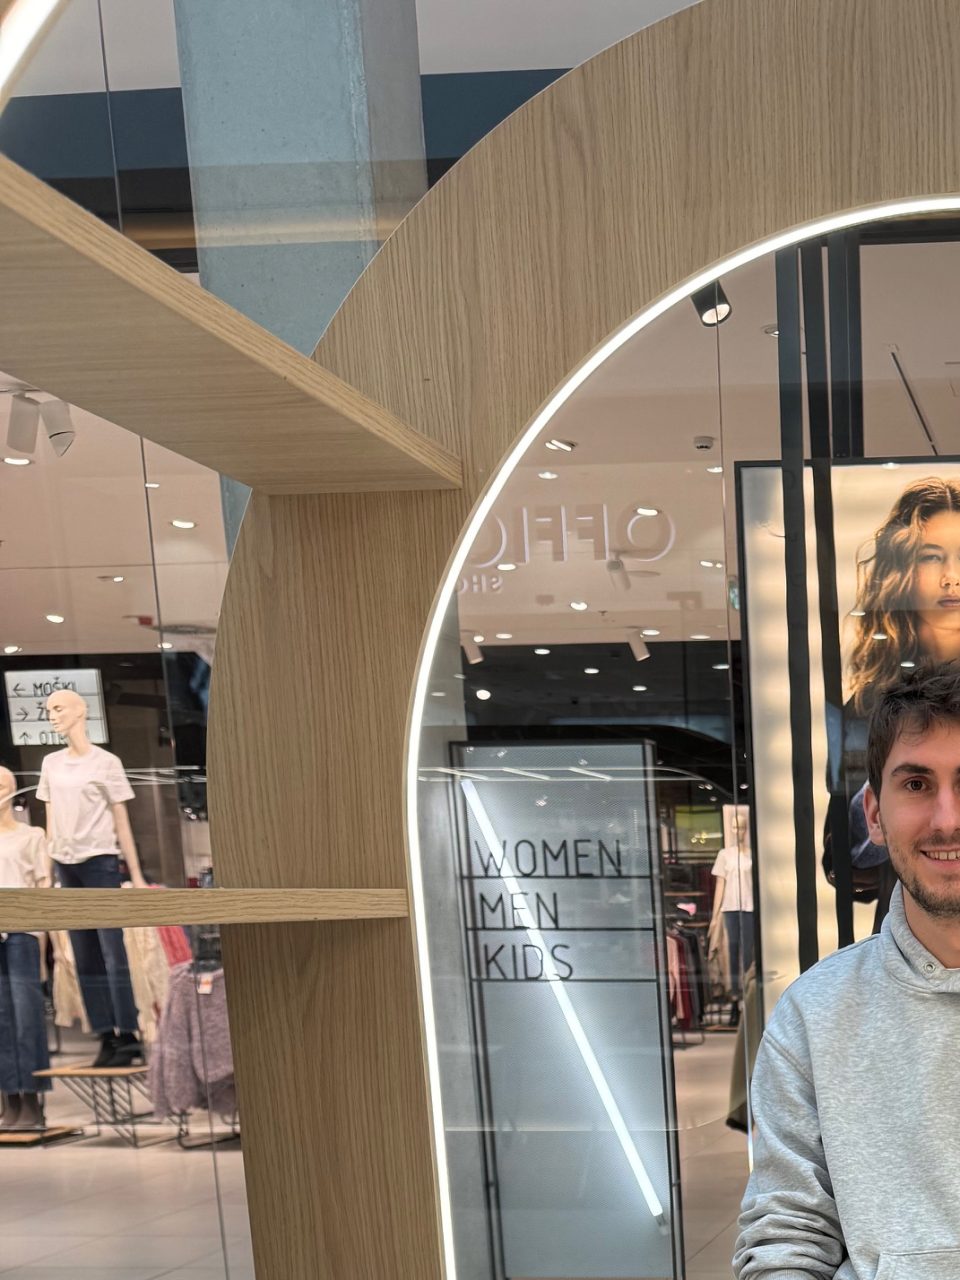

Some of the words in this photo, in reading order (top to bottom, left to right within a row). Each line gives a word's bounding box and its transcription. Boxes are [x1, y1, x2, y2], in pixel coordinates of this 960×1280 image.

[474, 839, 622, 877] WOMEN
[480, 892, 559, 929] MEN
[484, 944, 574, 981] KIDS
